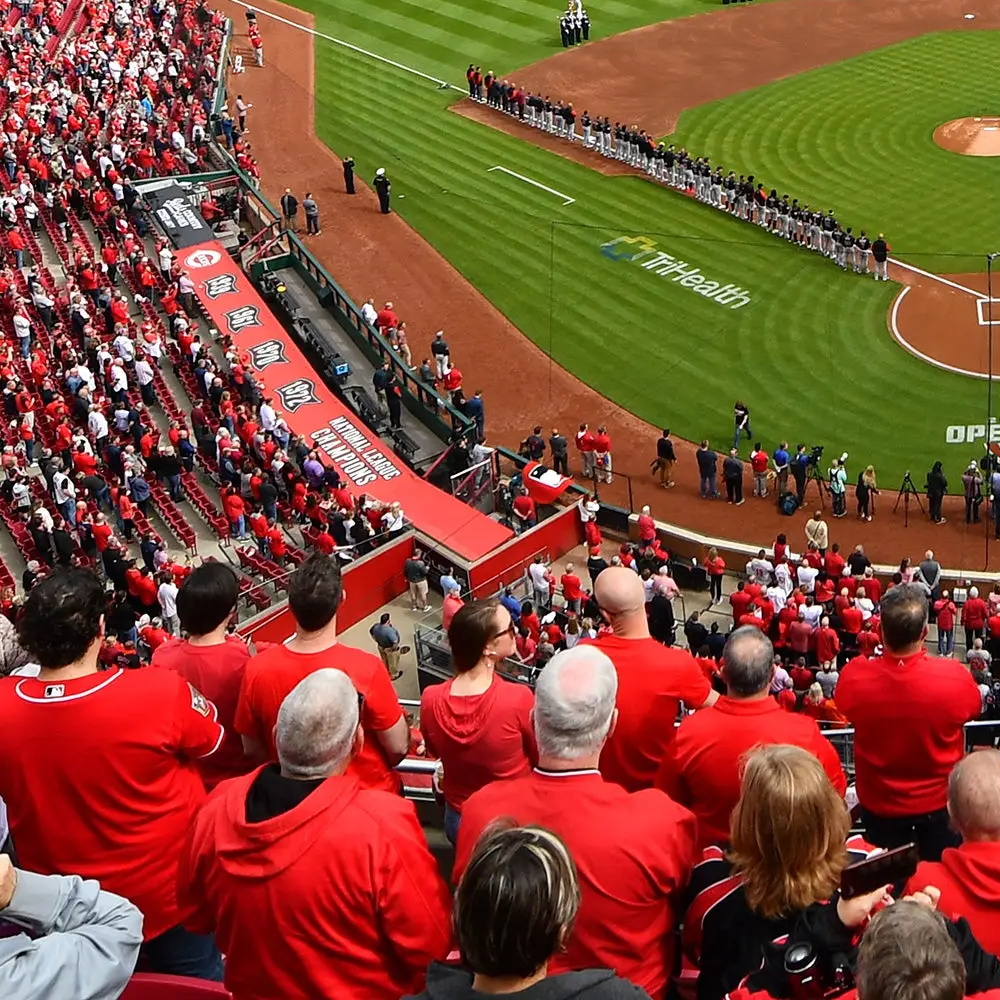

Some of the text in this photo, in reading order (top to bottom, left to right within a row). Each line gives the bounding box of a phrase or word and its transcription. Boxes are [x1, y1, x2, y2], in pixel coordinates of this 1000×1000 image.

[640, 251, 751, 309] TriHealth
[281, 380, 312, 408] 1972
[310, 427, 378, 486] CHAMPIONS
[328, 415, 401, 481] NATIONAL LEAGUE
